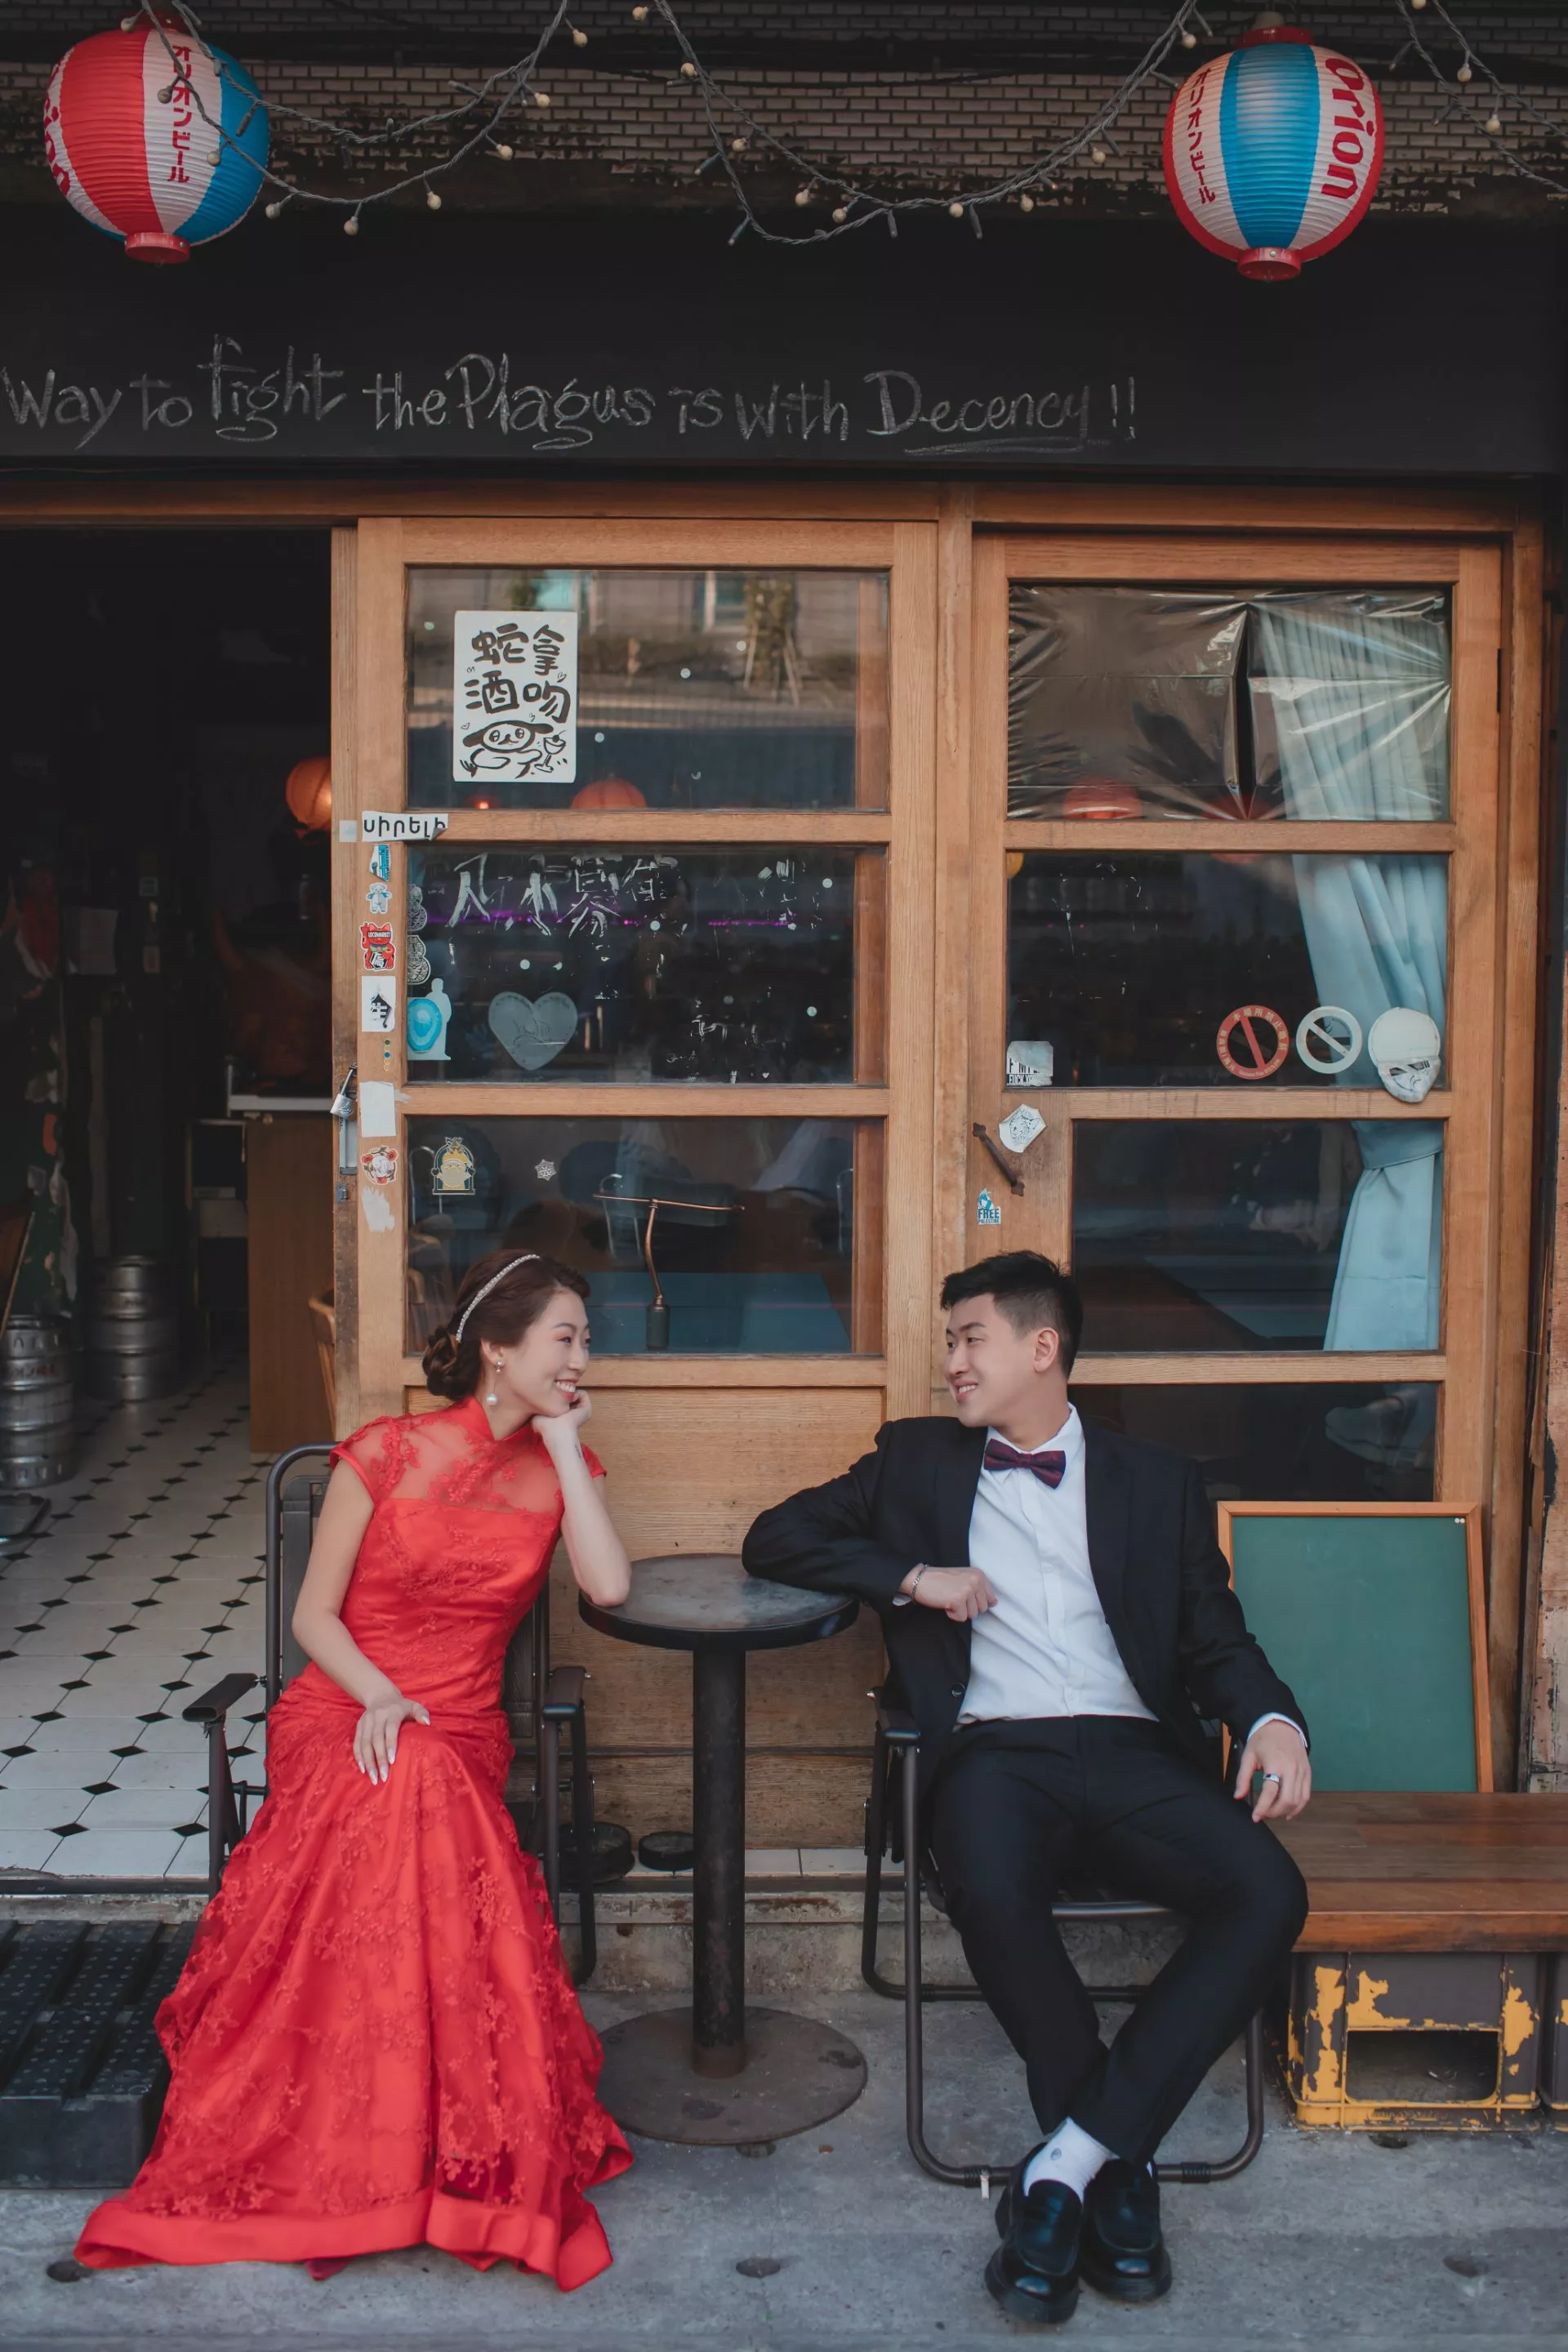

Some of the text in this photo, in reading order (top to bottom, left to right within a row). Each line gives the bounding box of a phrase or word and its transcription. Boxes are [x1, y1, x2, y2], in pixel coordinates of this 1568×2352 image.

[1187, 68, 1216, 204] オリオンビール
[1321, 58, 1375, 199] Orion
[2, 368, 122, 449] Way
[129, 373, 193, 430] to
[363, 370, 447, 430] the
[668, 387, 724, 434] is
[735, 379, 849, 441] with
[978, 1209, 1000, 1218] FREE
